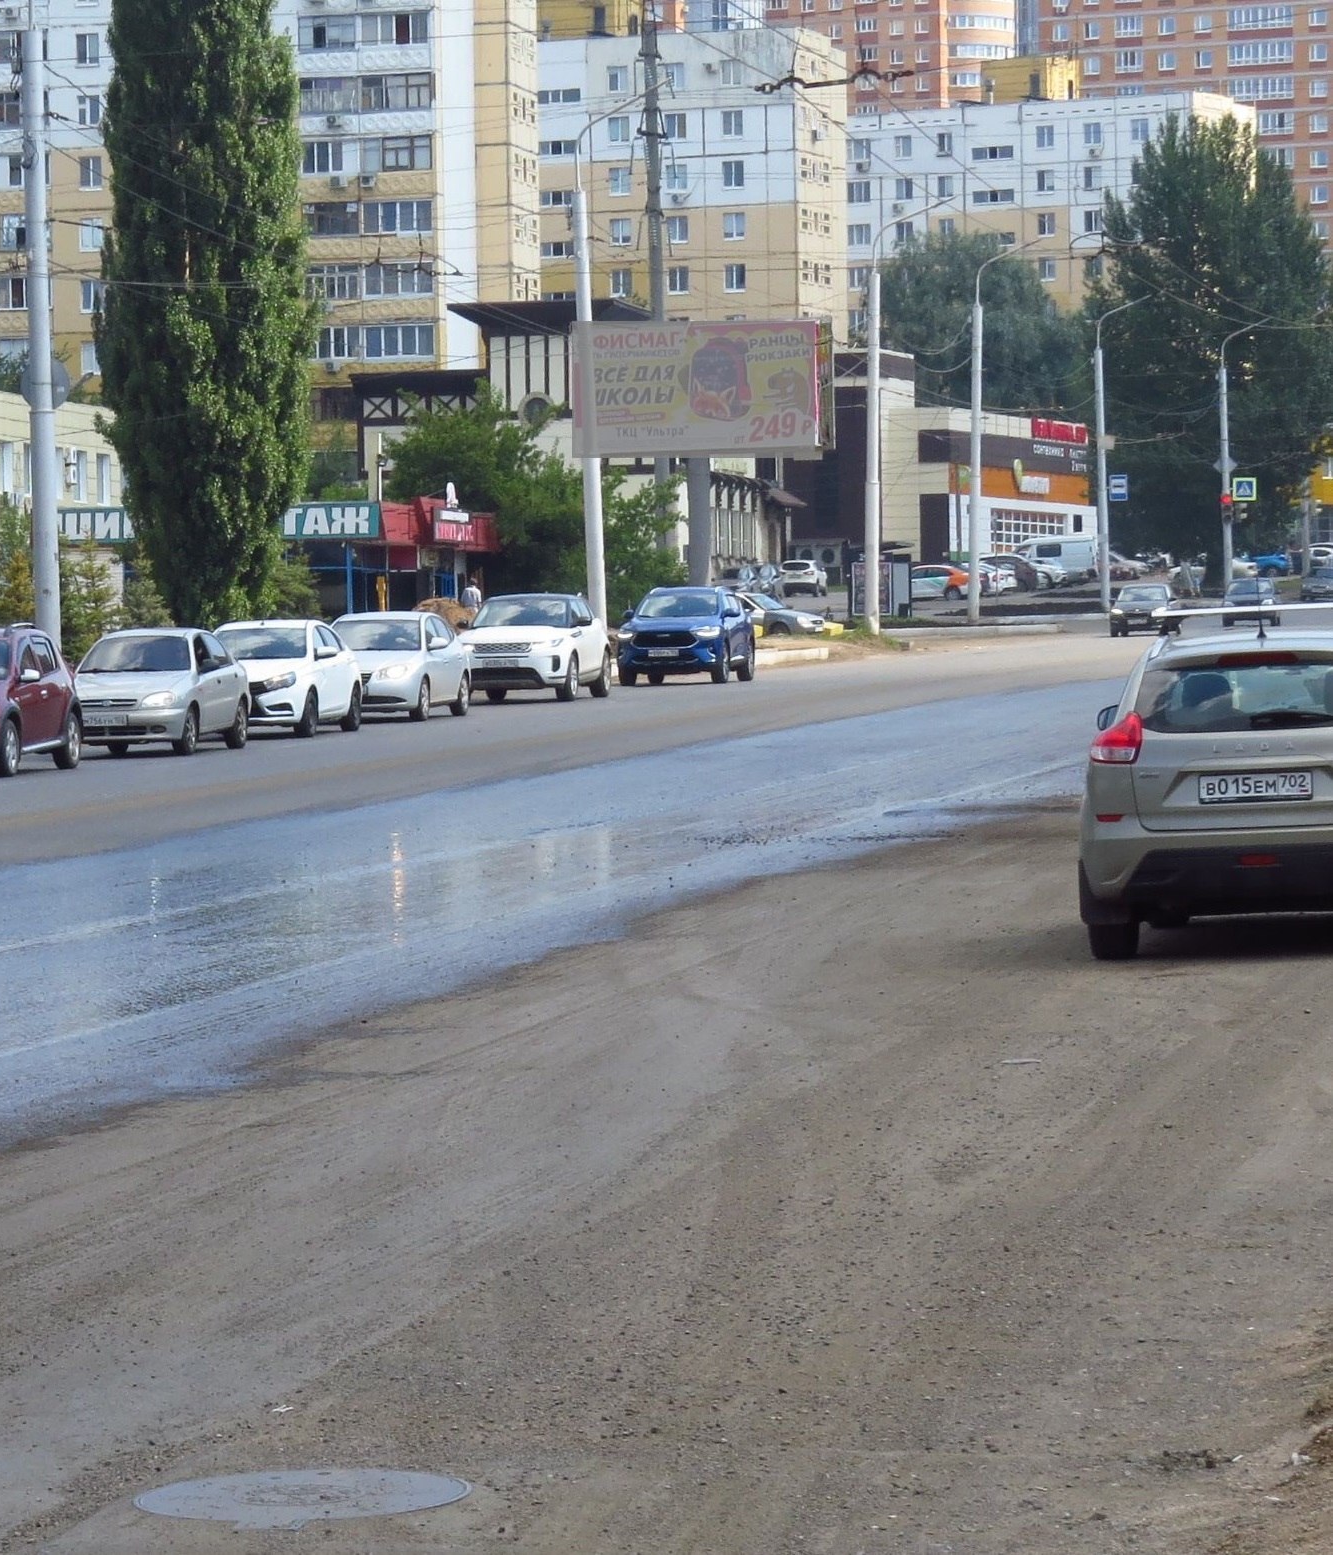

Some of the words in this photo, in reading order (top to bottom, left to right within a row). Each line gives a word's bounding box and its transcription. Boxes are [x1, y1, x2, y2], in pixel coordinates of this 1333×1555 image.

[750, 334, 804, 348] РАНЦЫ
[747, 348, 810, 361] РЮКЗАКИ
[632, 365, 675, 382] ДЛЯ
[617, 427, 637, 437] ТКЦ
[749, 411, 796, 441] 249
[1213, 740, 1294, 753] LADA
